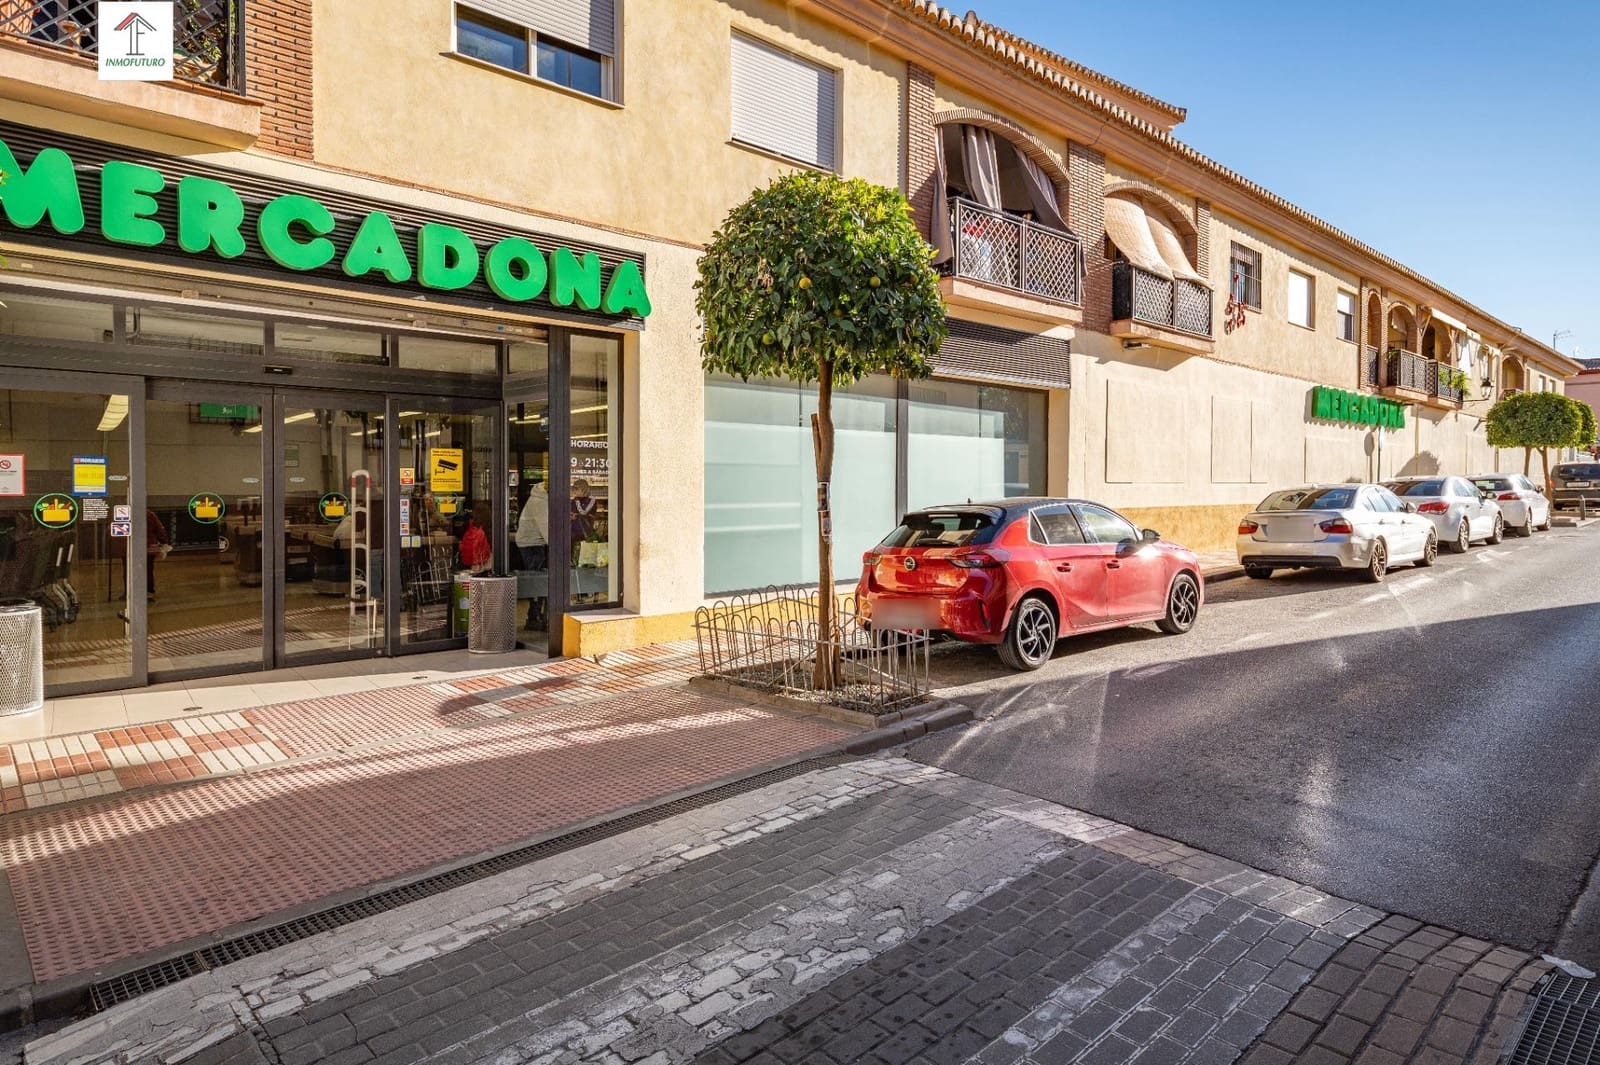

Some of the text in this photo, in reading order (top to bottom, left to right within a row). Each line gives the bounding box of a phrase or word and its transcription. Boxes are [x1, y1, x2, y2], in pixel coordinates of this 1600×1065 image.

[0, 139, 652, 318] MERCADONA
[1313, 385, 1405, 429] MERCADONA
[570, 439, 609, 449] HORARIO
[570, 457, 578, 467] 9
